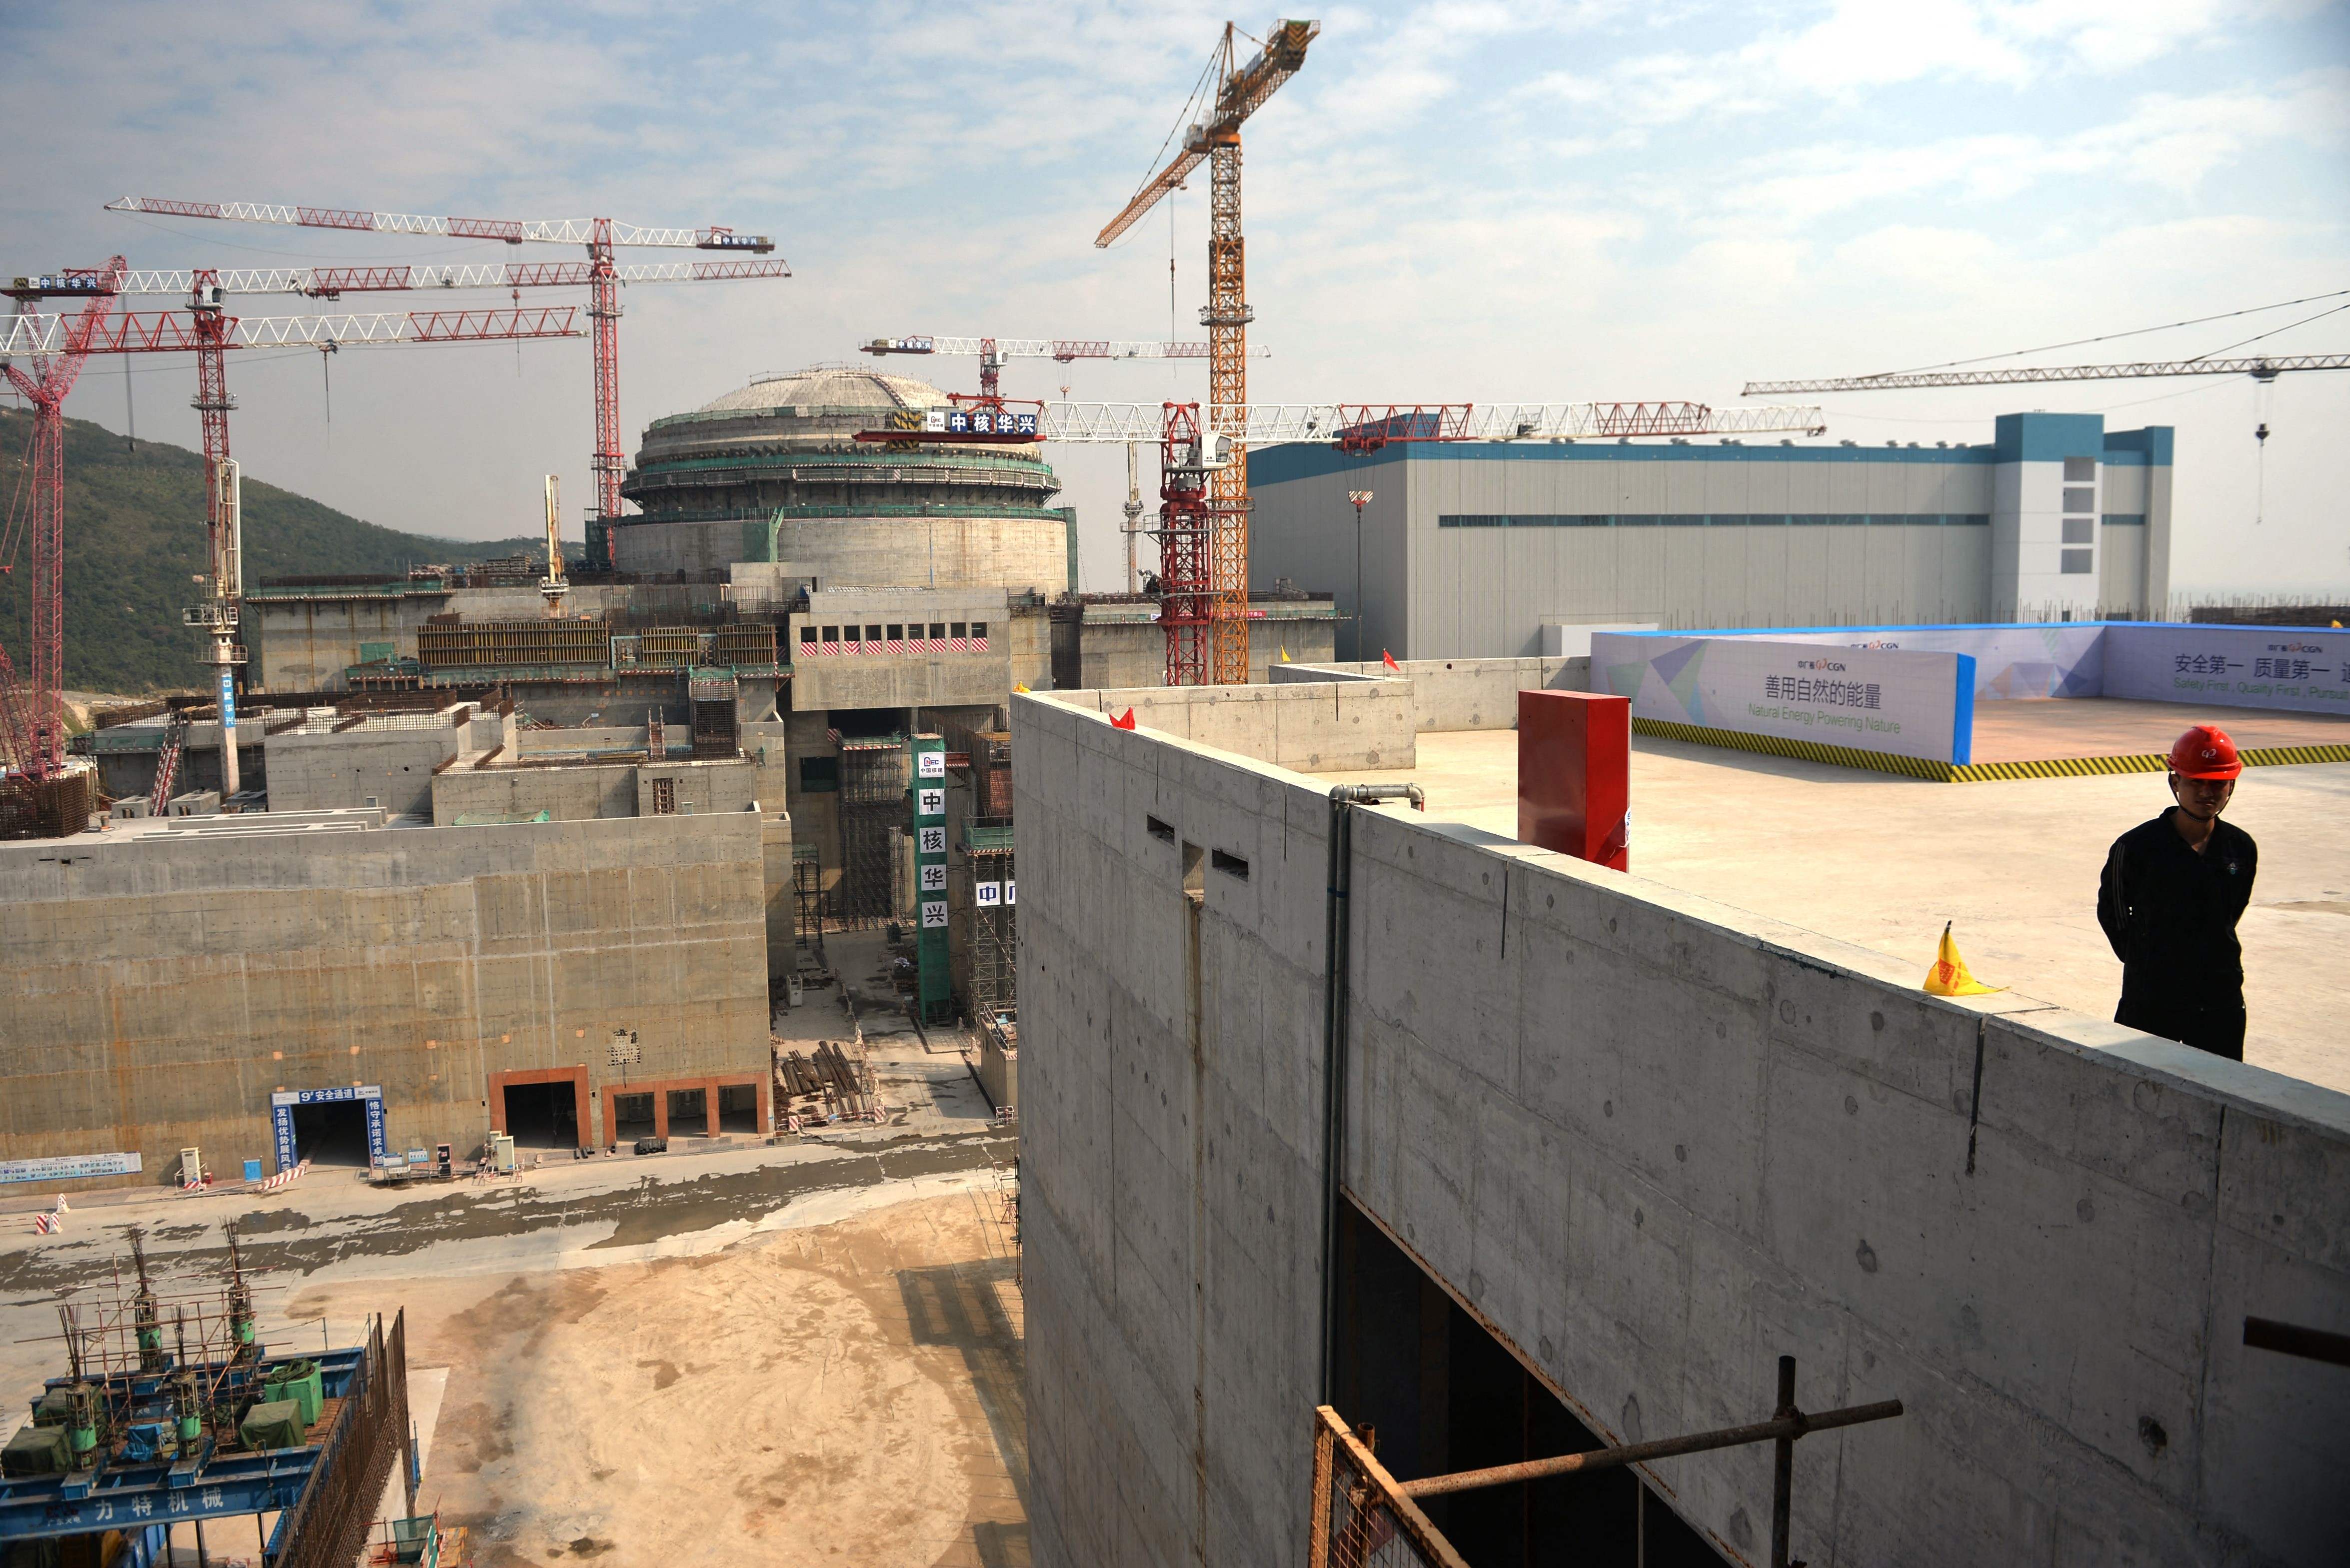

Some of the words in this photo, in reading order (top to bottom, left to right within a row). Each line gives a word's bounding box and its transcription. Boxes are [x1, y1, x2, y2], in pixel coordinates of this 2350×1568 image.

[41, 278, 96, 288] 中核华兴
[952, 413, 1034, 433] 中核华兴
[1827, 662, 1846, 671] CGN
[2175, 653, 2244, 675] 安全第一
[2254, 658, 2330, 680] 质量第一
[1765, 675, 1882, 710] 善用自然的能量
[2174, 677, 2205, 691] Safety
[2208, 680, 2229, 692] First
[2237, 682, 2273, 697] Quality
[2277, 684, 2300, 696] First
[1749, 703, 1780, 718] Natural
[1782, 707, 1815, 725] Energy
[1817, 711, 1863, 731] Powering
[1866, 717, 1901, 734] Nature
[922, 792, 945, 925] 中核华兴
[369, 1101, 383, 1165] 恪守承诺求卓越
[95, 1487, 223, 1521] 力特机械
